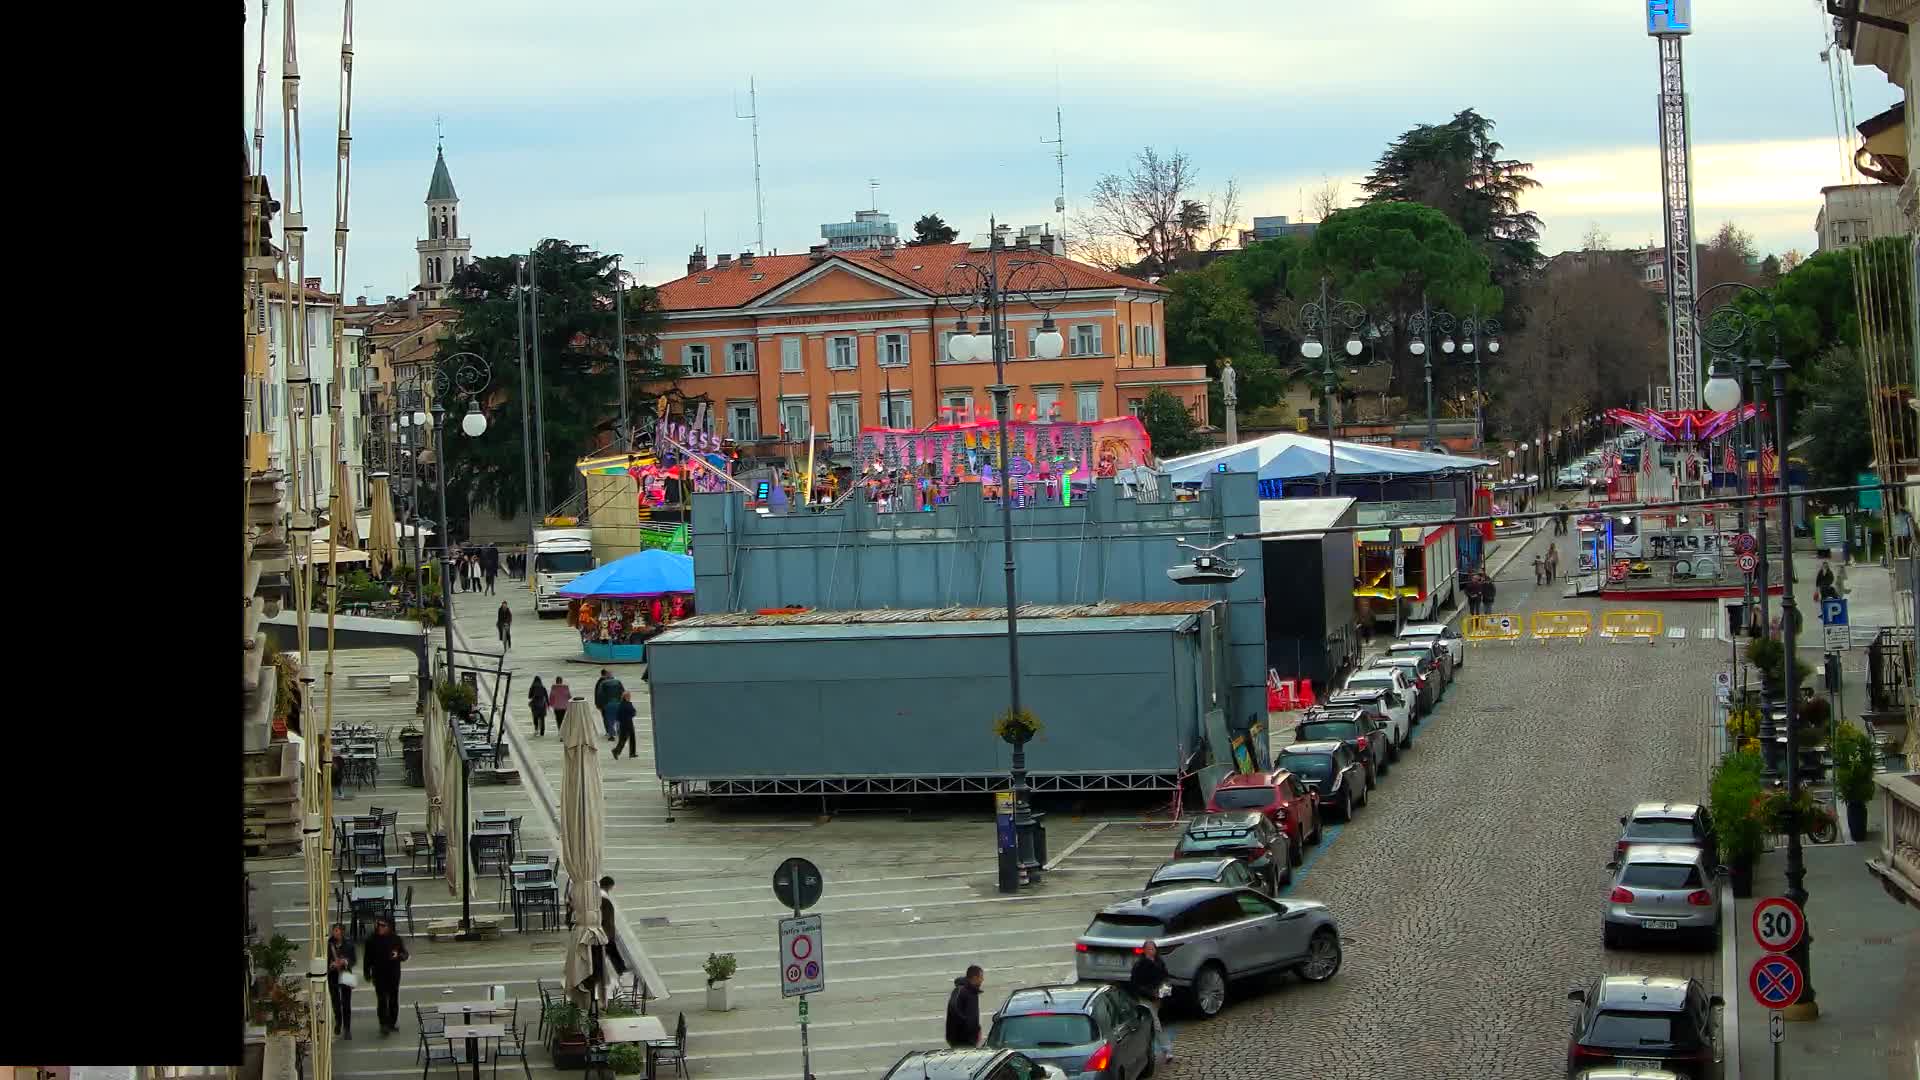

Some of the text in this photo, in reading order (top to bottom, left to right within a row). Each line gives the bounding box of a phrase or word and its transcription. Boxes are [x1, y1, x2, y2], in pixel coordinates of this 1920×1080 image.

[1742, 558, 1752, 567] 20
[1826, 602, 1842, 622] P
[1762, 912, 1792, 938] 30
[790, 970, 798, 978] 20
